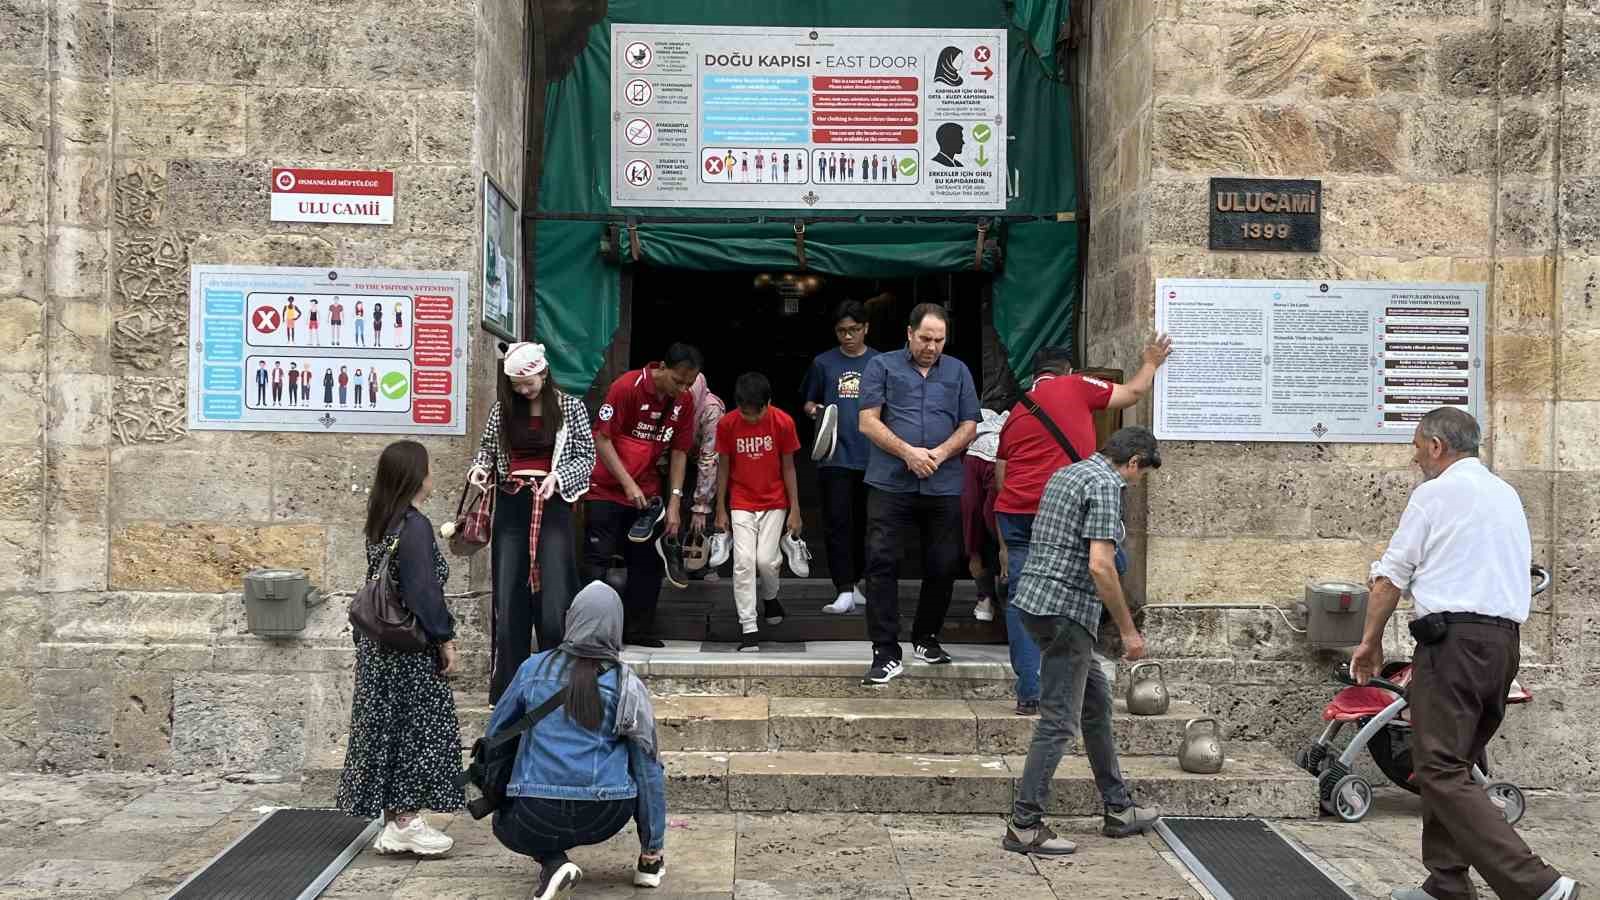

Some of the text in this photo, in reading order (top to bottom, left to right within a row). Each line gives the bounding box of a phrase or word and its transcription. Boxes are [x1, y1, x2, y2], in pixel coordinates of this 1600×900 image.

[705, 52, 753, 68] DOĞU
[758, 55, 811, 68] KAPISI
[827, 56, 865, 69] EAST
[869, 56, 918, 70] DOOR
[298, 178, 379, 189] OSMANGAZİ MÜFTÜLÜĞÜ
[298, 201, 380, 216] ULU CAMİİ
[1216, 190, 1317, 213] ULUCAMİ
[1241, 222, 1290, 240] 1399
